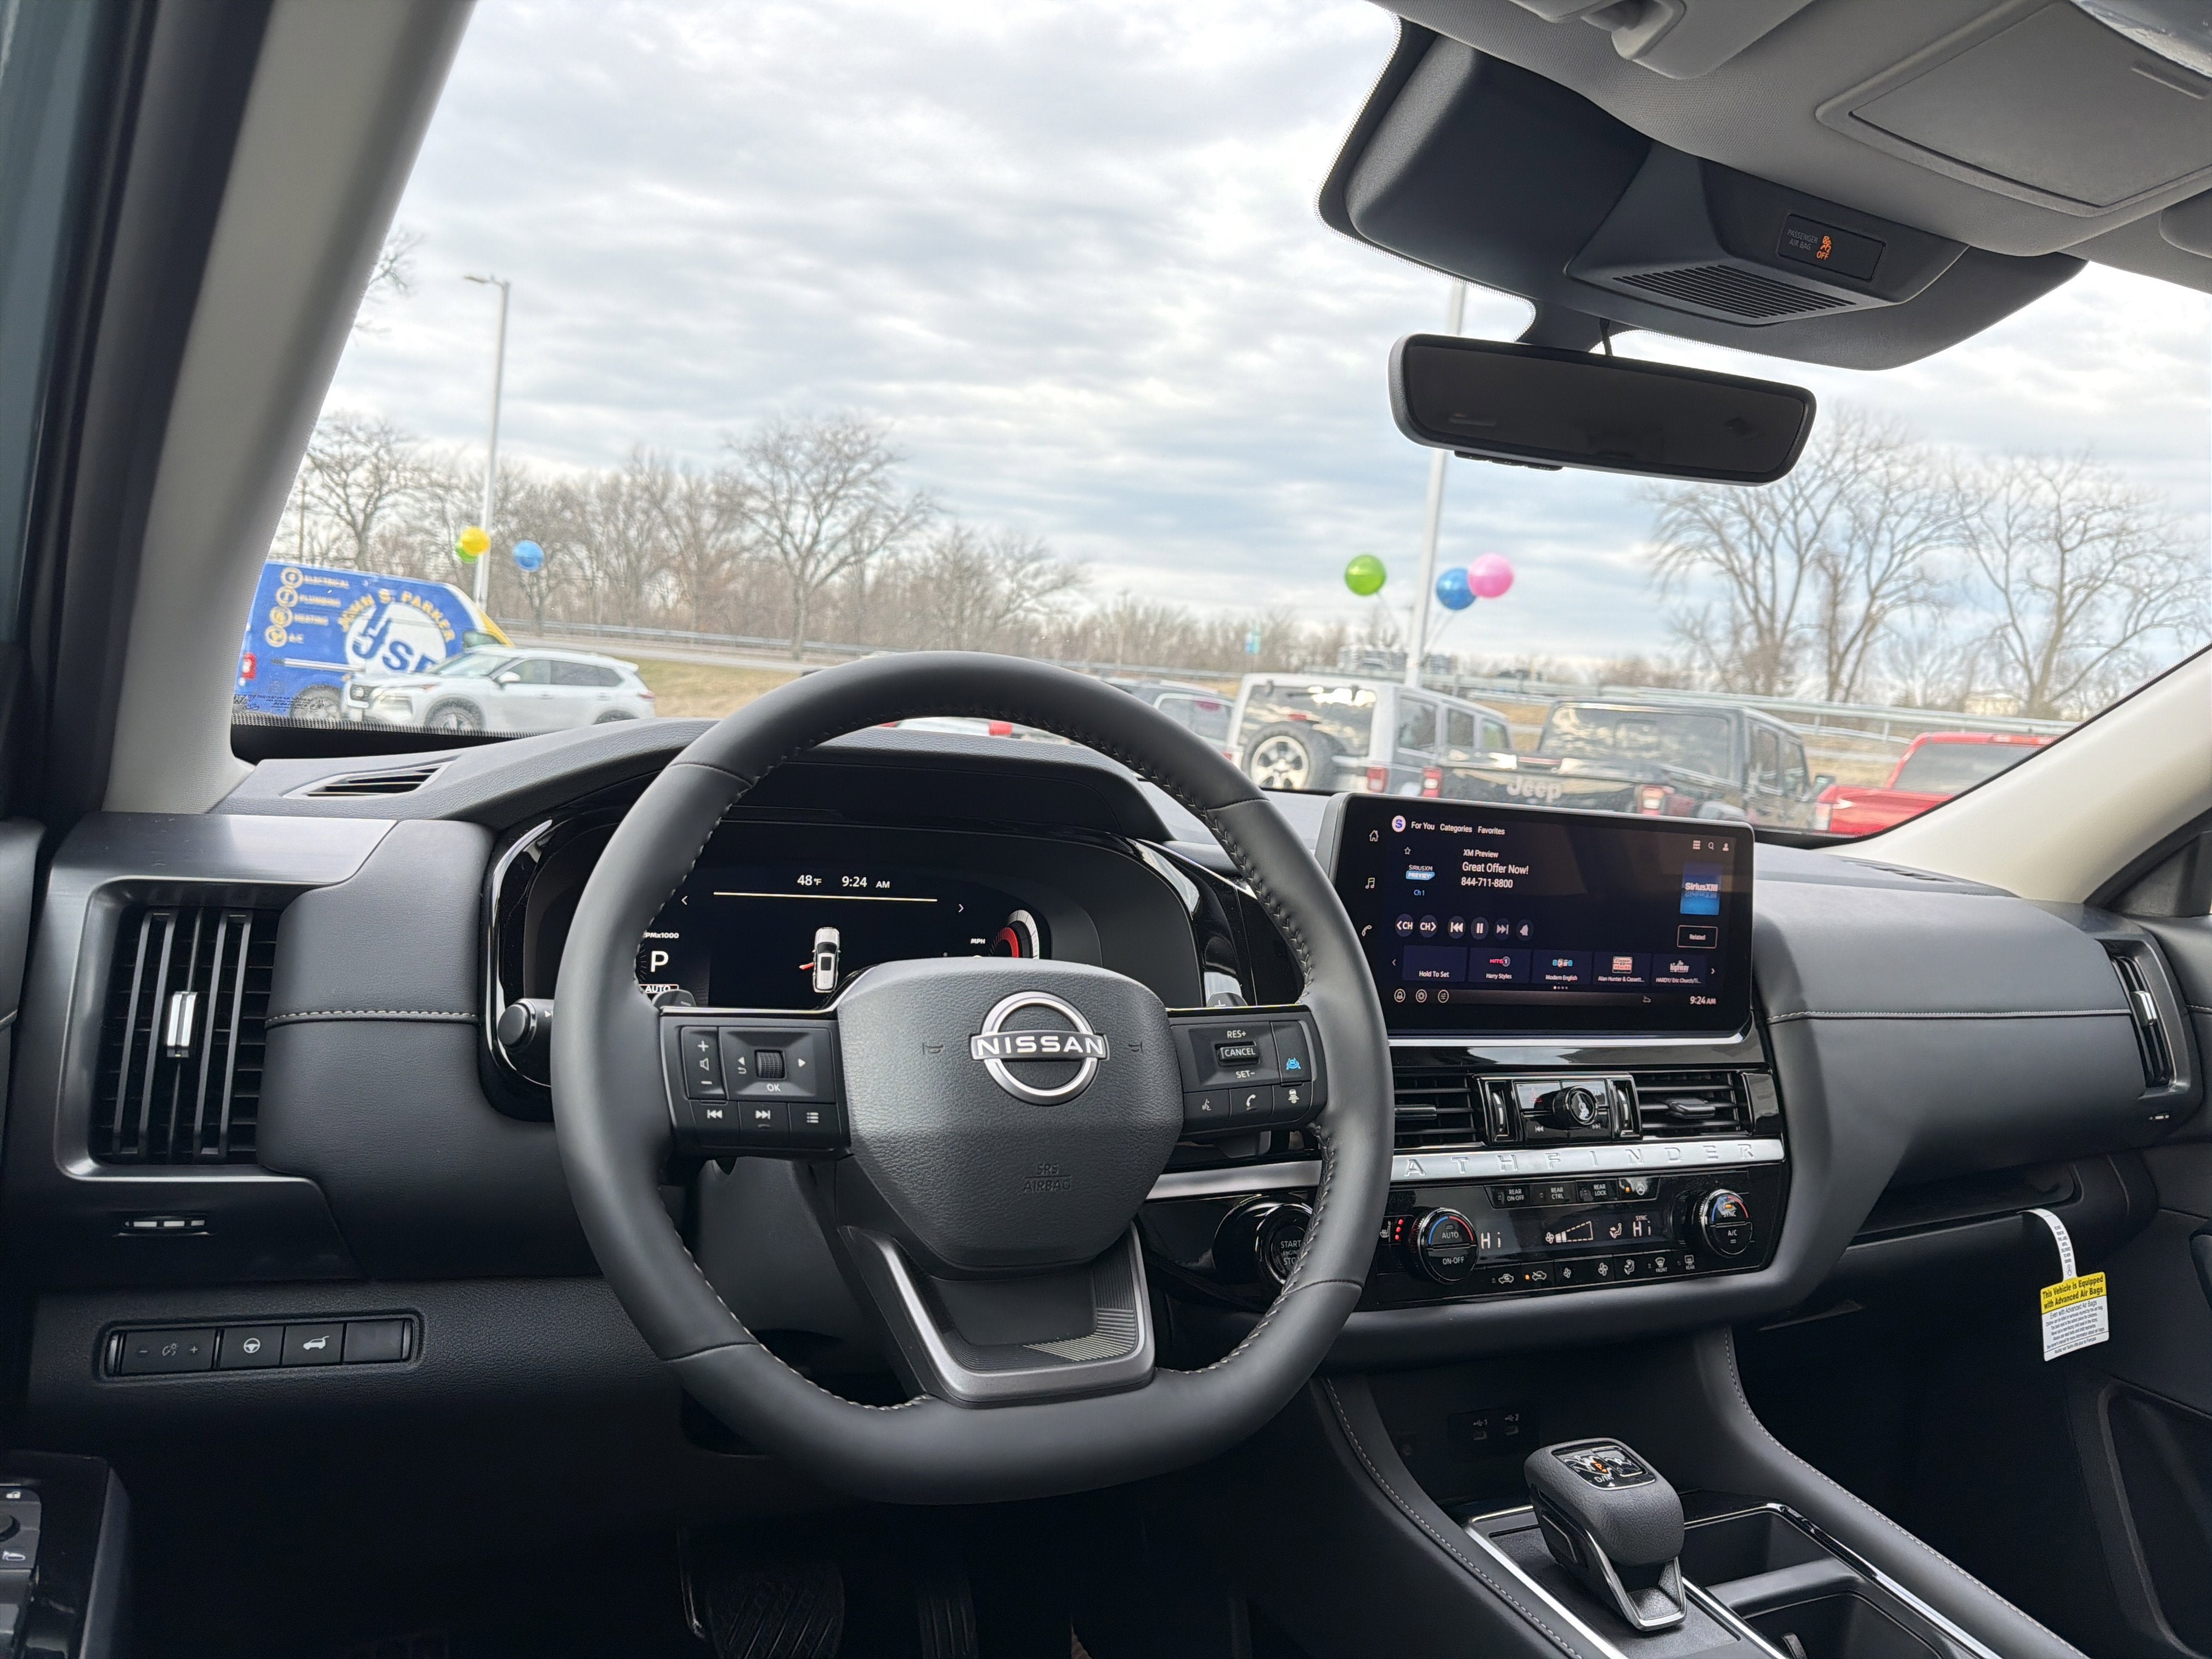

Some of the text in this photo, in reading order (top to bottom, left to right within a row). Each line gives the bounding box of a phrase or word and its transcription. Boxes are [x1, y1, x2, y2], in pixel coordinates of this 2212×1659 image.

[1787, 229, 1818, 244] PASSENGER
[1788, 238, 1811, 250] AIR BAG
[1816, 251, 1830, 260] OFF
[1506, 775, 1561, 803] Jeep
[1411, 821, 1435, 831] For You
[1440, 823, 1472, 833] Categories
[1478, 826, 1505, 835] Favorites
[1475, 850, 1499, 858] Preview
[1462, 862, 1530, 874] Great Offer Now!
[842, 876, 867, 887] 9:24
[1461, 877, 1514, 888] 844-711-8800
[1685, 882, 1718, 891] SiriusXM
[650, 950, 669, 973] P
[1690, 996, 1706, 1005] 9:24
[1227, 1030, 1247, 1039] RES+
[977, 1035, 1103, 1056] NISSAN
[1224, 1047, 1256, 1057] CANCEL
[766, 1084, 781, 1092] OK
[1403, 1143, 1756, 1178] ATHFINDER
[1036, 1164, 1059, 1175] SRS
[1023, 1180, 1071, 1192] AIRBAG
[1280, 1240, 1301, 1249] START
[2042, 1289, 2052, 1300] This
[2053, 1283, 2072, 1295] Vehicle
[2078, 1274, 2103, 1289] Equipped
[2044, 1301, 2054, 1310] with
[2055, 1291, 2079, 1306] Advanced
[2089, 1286, 2103, 1295] Bags
